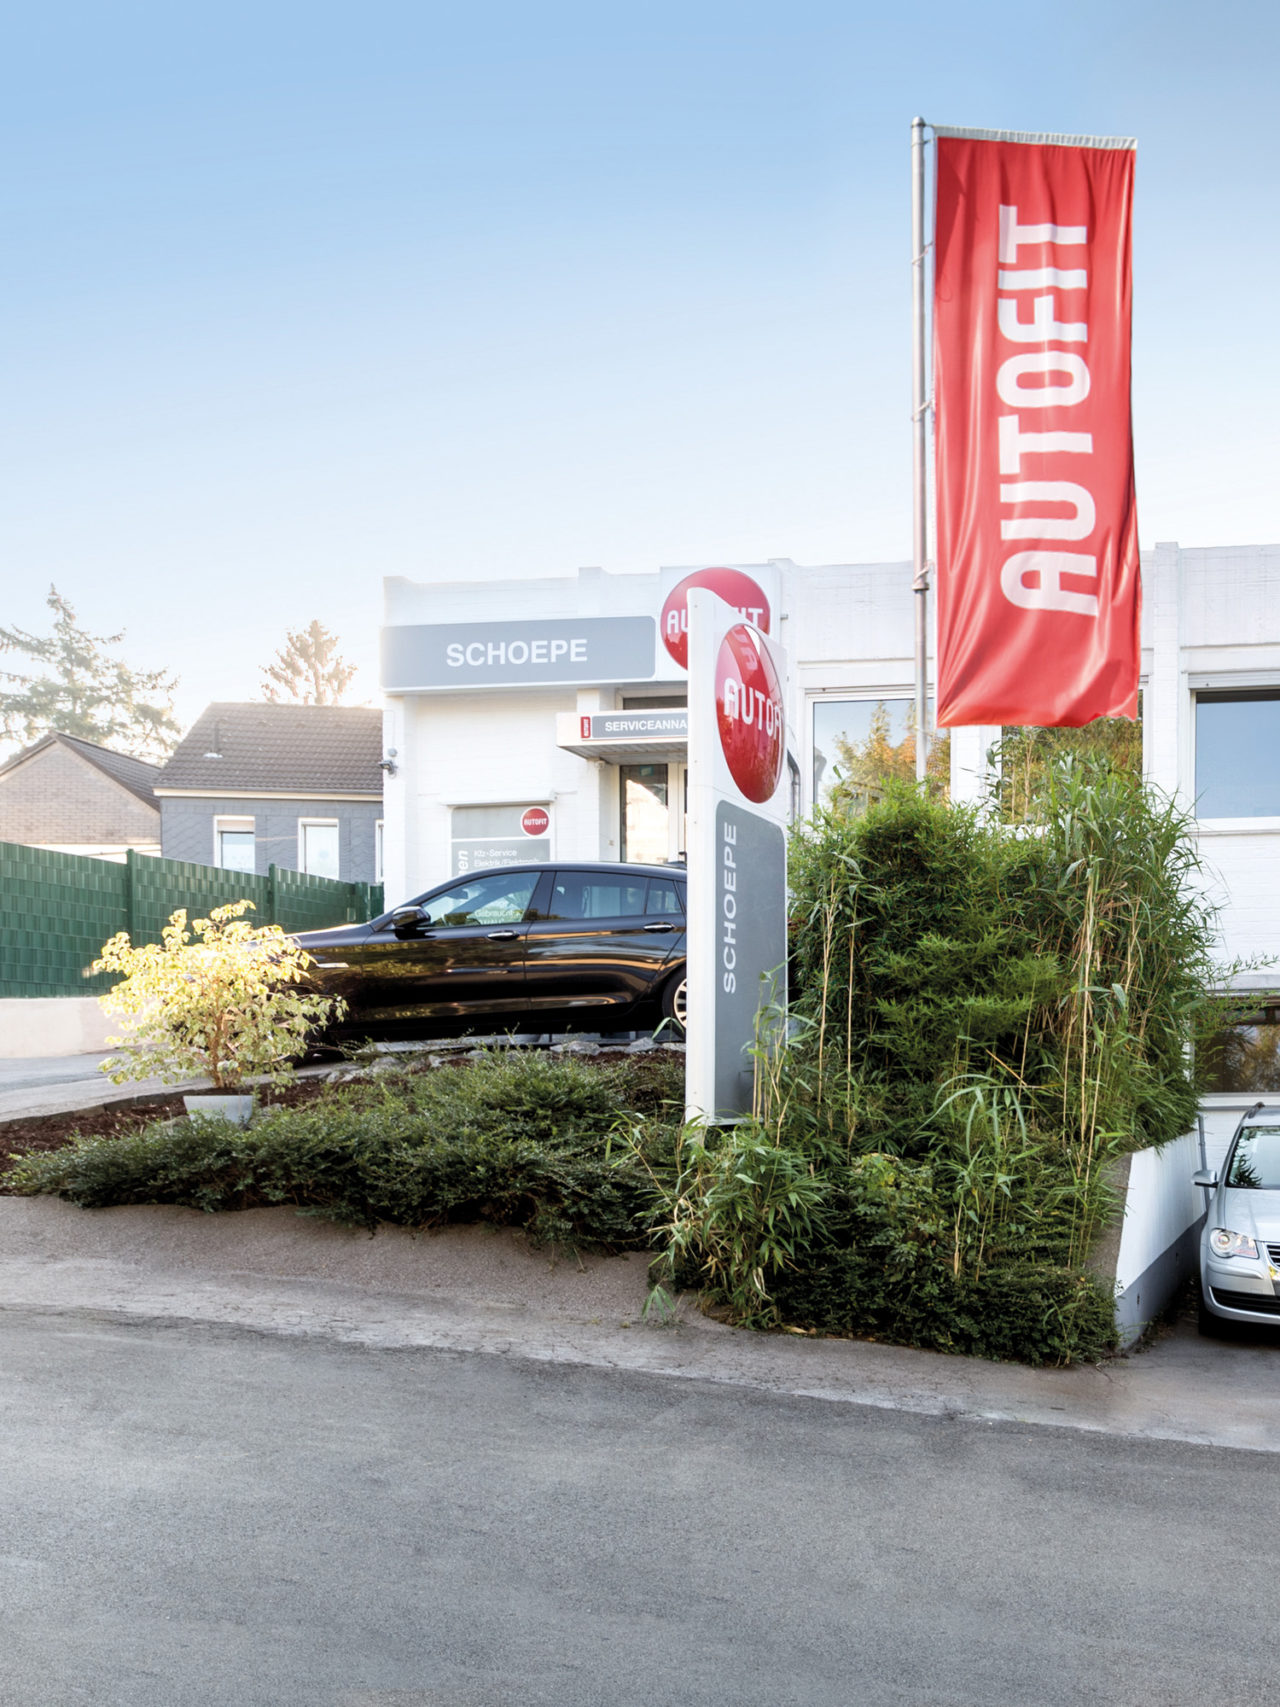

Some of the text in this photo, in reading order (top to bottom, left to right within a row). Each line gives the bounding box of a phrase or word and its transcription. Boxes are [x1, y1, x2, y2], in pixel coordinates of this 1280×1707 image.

[996, 204, 1099, 617] AUTOFIT
[446, 638, 588, 667] SCHOEPE
[723, 822, 737, 994] SCHOEPE
